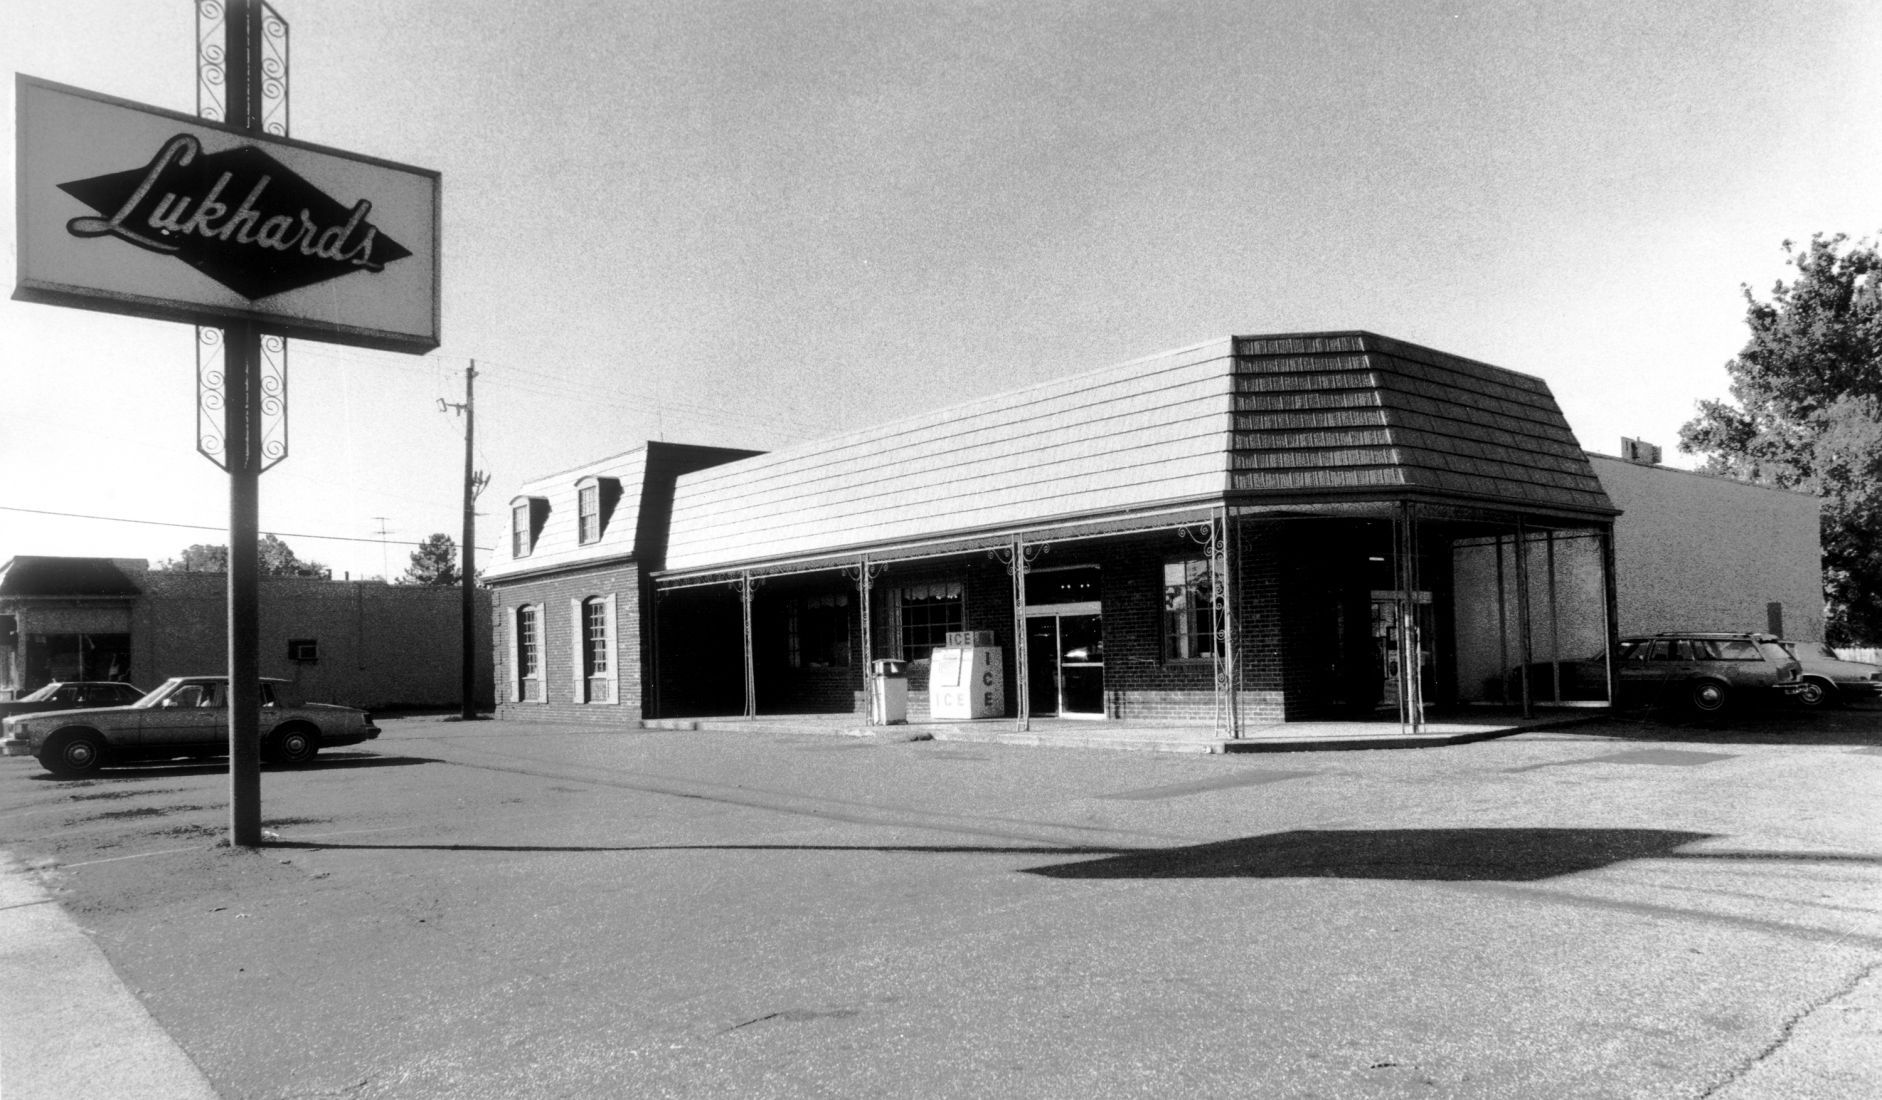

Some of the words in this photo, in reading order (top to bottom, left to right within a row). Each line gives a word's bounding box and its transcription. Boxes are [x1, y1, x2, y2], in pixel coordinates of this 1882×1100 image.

[949, 632, 971, 645] ICE
[982, 652, 993, 707] ICE
[936, 693, 965, 707] ICE
